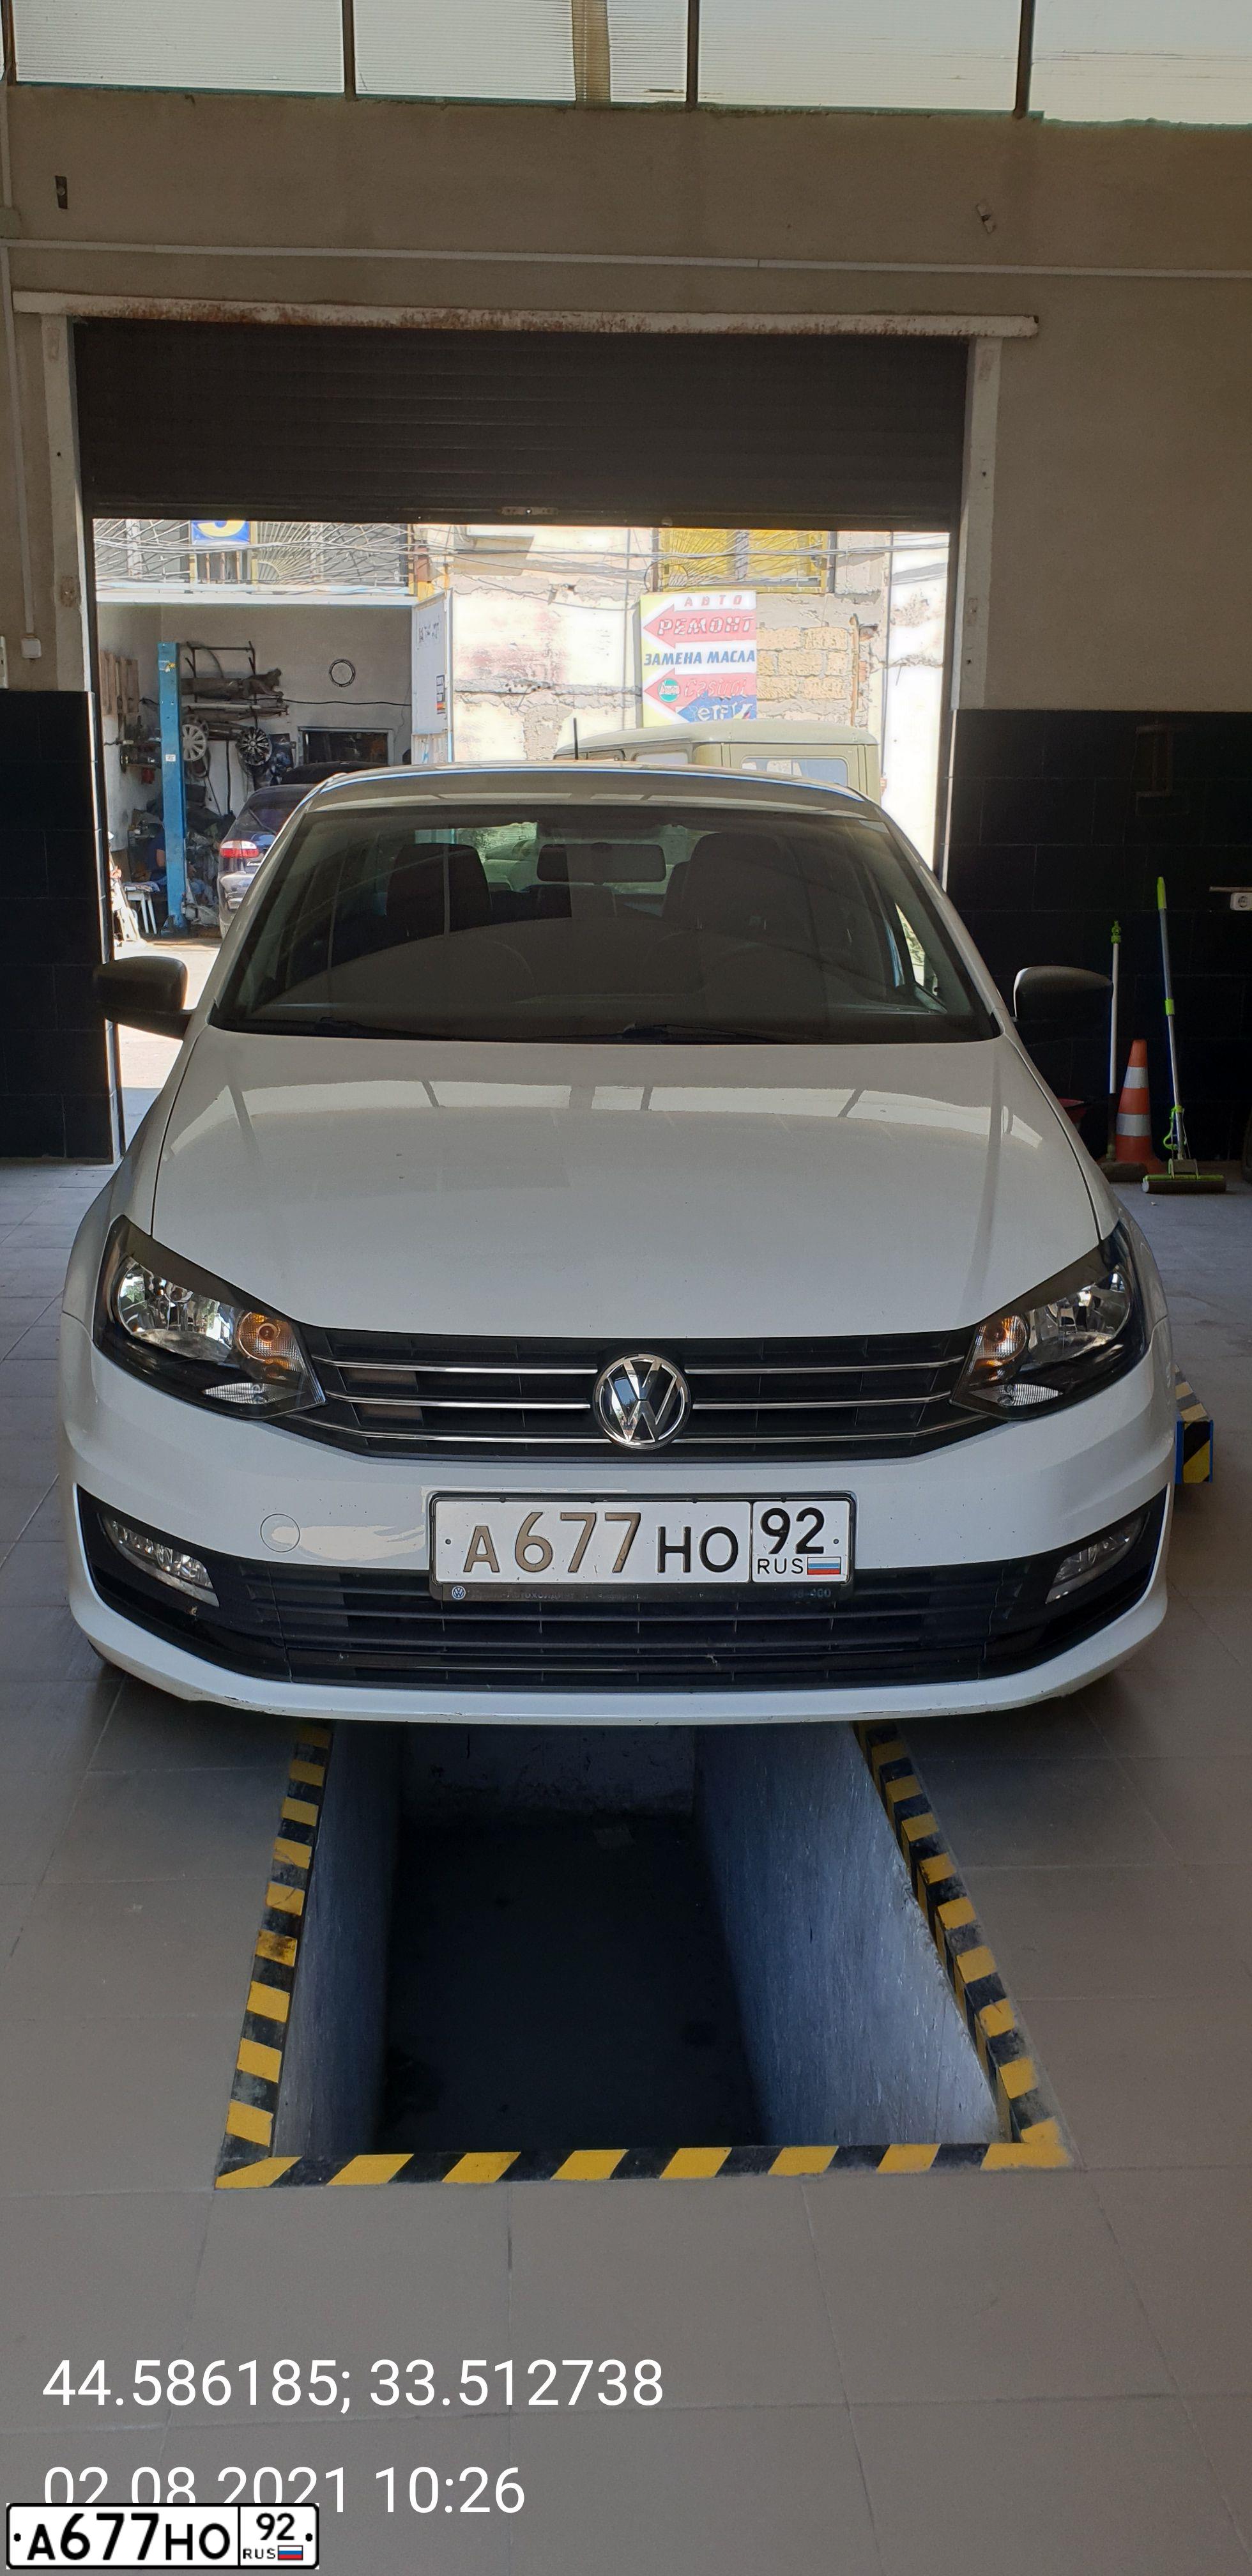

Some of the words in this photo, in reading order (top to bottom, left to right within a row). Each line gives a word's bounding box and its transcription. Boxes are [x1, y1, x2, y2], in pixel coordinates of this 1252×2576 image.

[657, 615, 755, 636] РЕМОНТ
[643, 652, 703, 666] ЗАМЕНА
[706, 650, 756, 664] МАСЛА
[760, 1507, 824, 1554] 92
[758, 1558, 804, 1575] RUS
